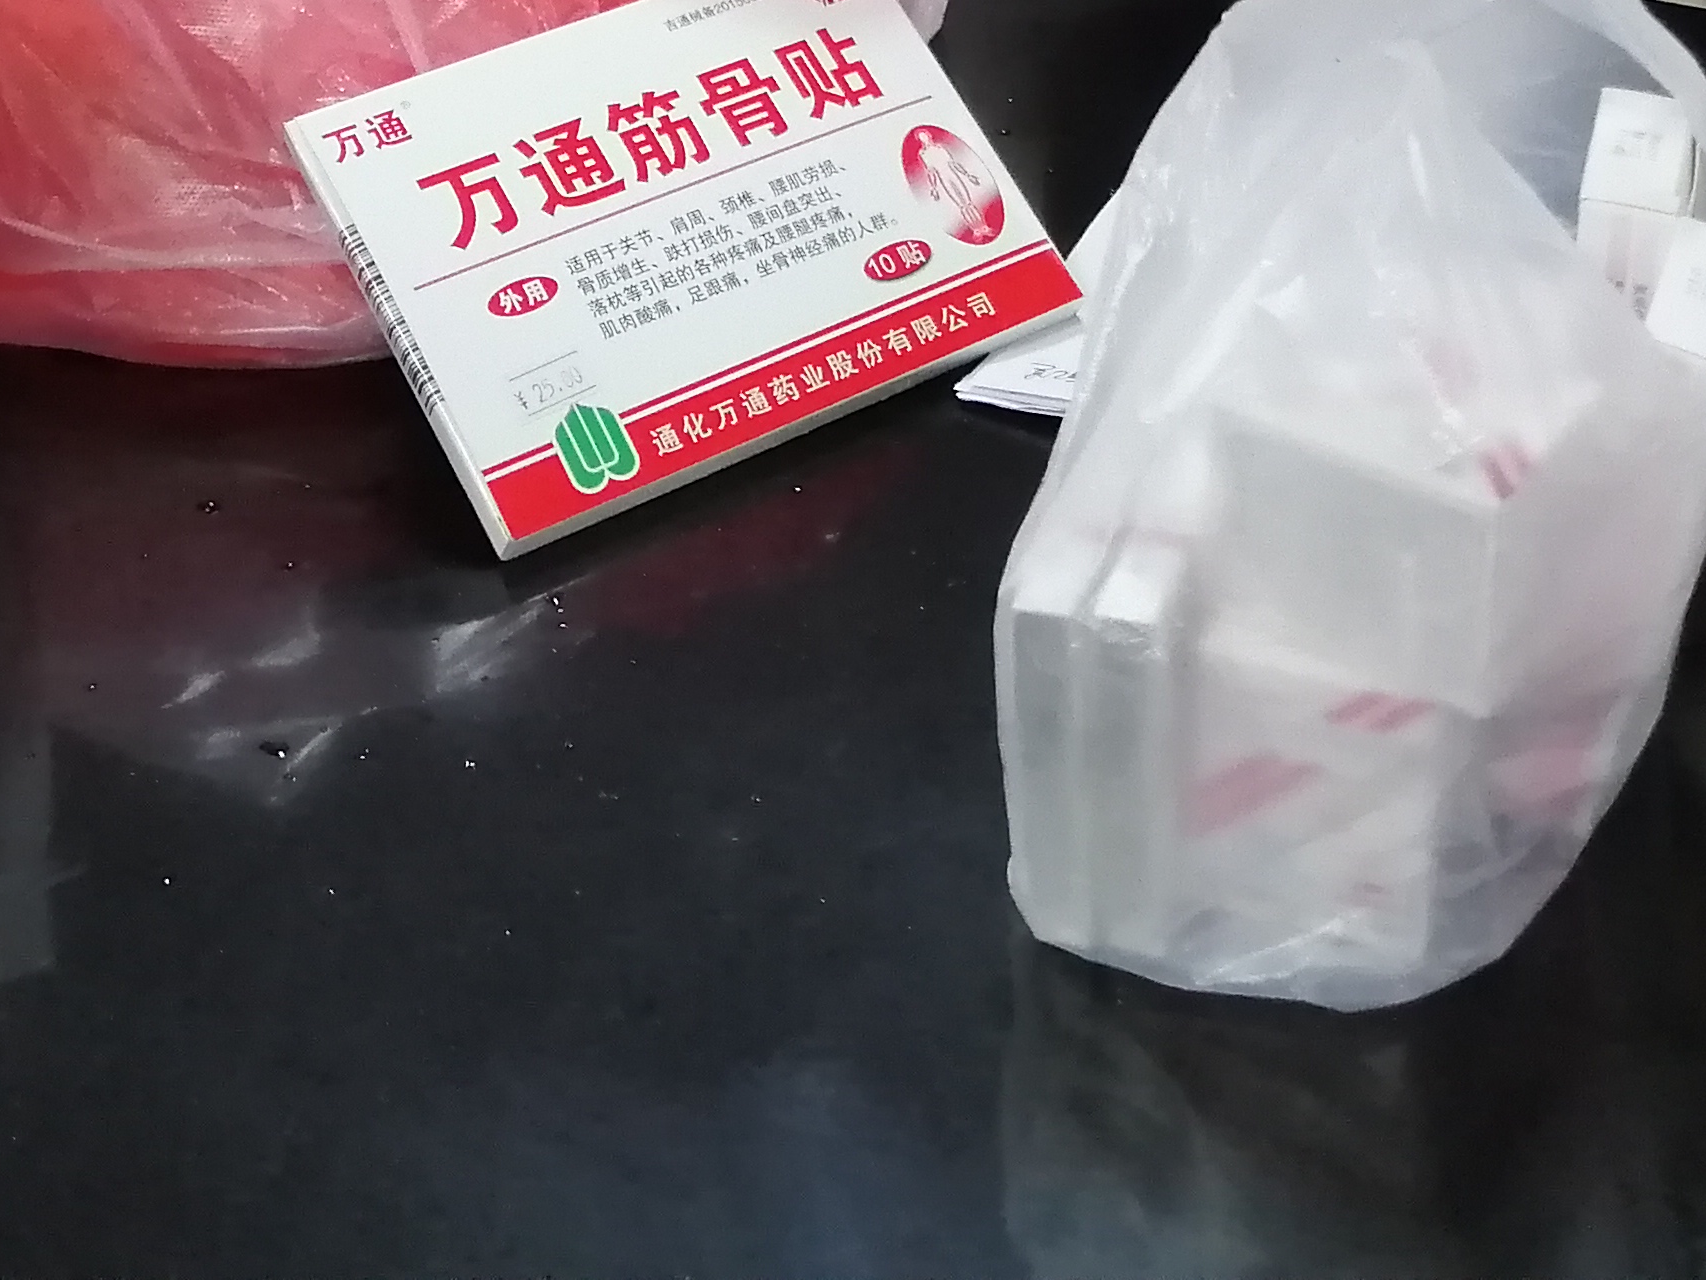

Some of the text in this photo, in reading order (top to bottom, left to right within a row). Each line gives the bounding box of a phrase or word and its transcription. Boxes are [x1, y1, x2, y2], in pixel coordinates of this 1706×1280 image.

[321, 107, 414, 165] 万通
[415, 25, 885, 252] 万通筋骨贴
[496, 278, 550, 315] 外用
[649, 290, 999, 459] 通化万通药业股份有限公司
